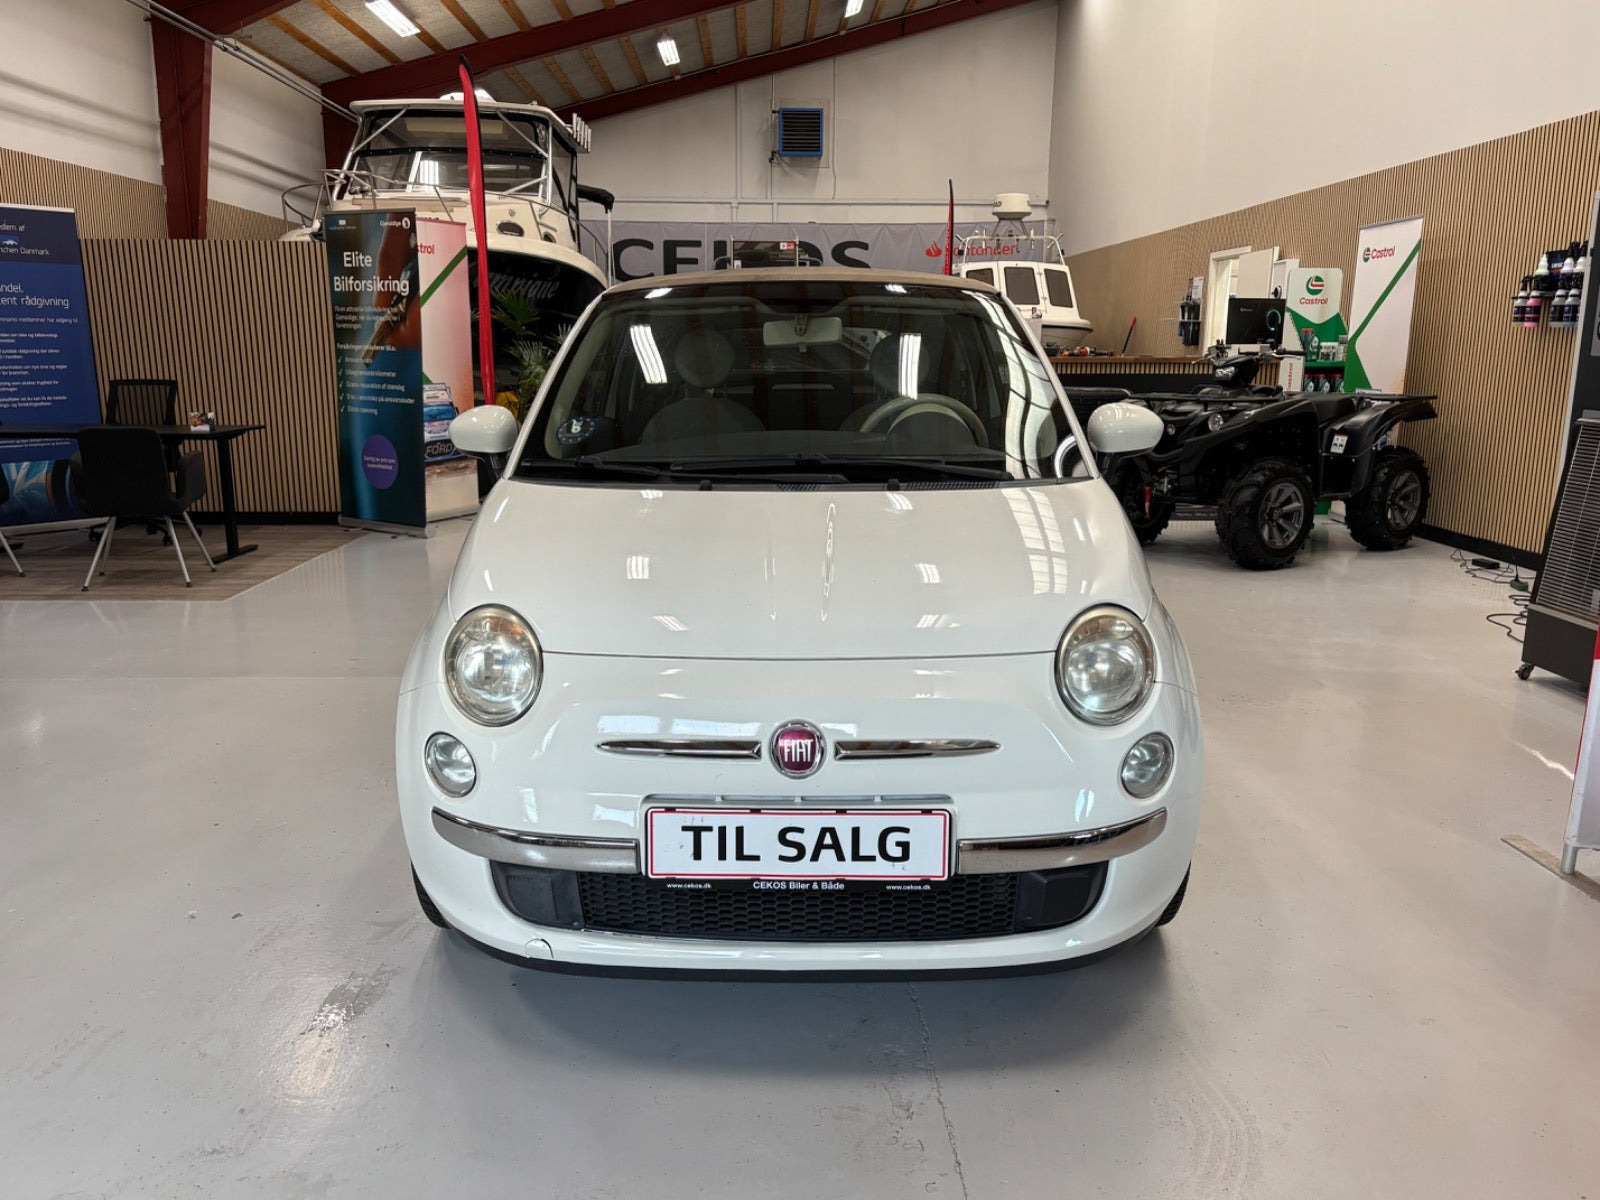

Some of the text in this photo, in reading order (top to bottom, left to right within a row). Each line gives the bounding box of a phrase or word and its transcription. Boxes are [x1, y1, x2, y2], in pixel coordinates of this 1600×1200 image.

[20, 247, 50, 256] Danmark
[1371, 245, 1396, 259] Castrol
[343, 251, 373, 268] Elite
[333, 276, 410, 297] Bilforsikring
[21, 295, 70, 310] rådgivning
[1299, 297, 1329, 305] Castrol
[426, 441, 454, 456] FORD
[782, 738, 815, 763] FIAT
[681, 825, 911, 863] TIL SALG
[666, 880, 931, 891] www.cekos.dk CEKOS Biler & Både www.cekos.dk
